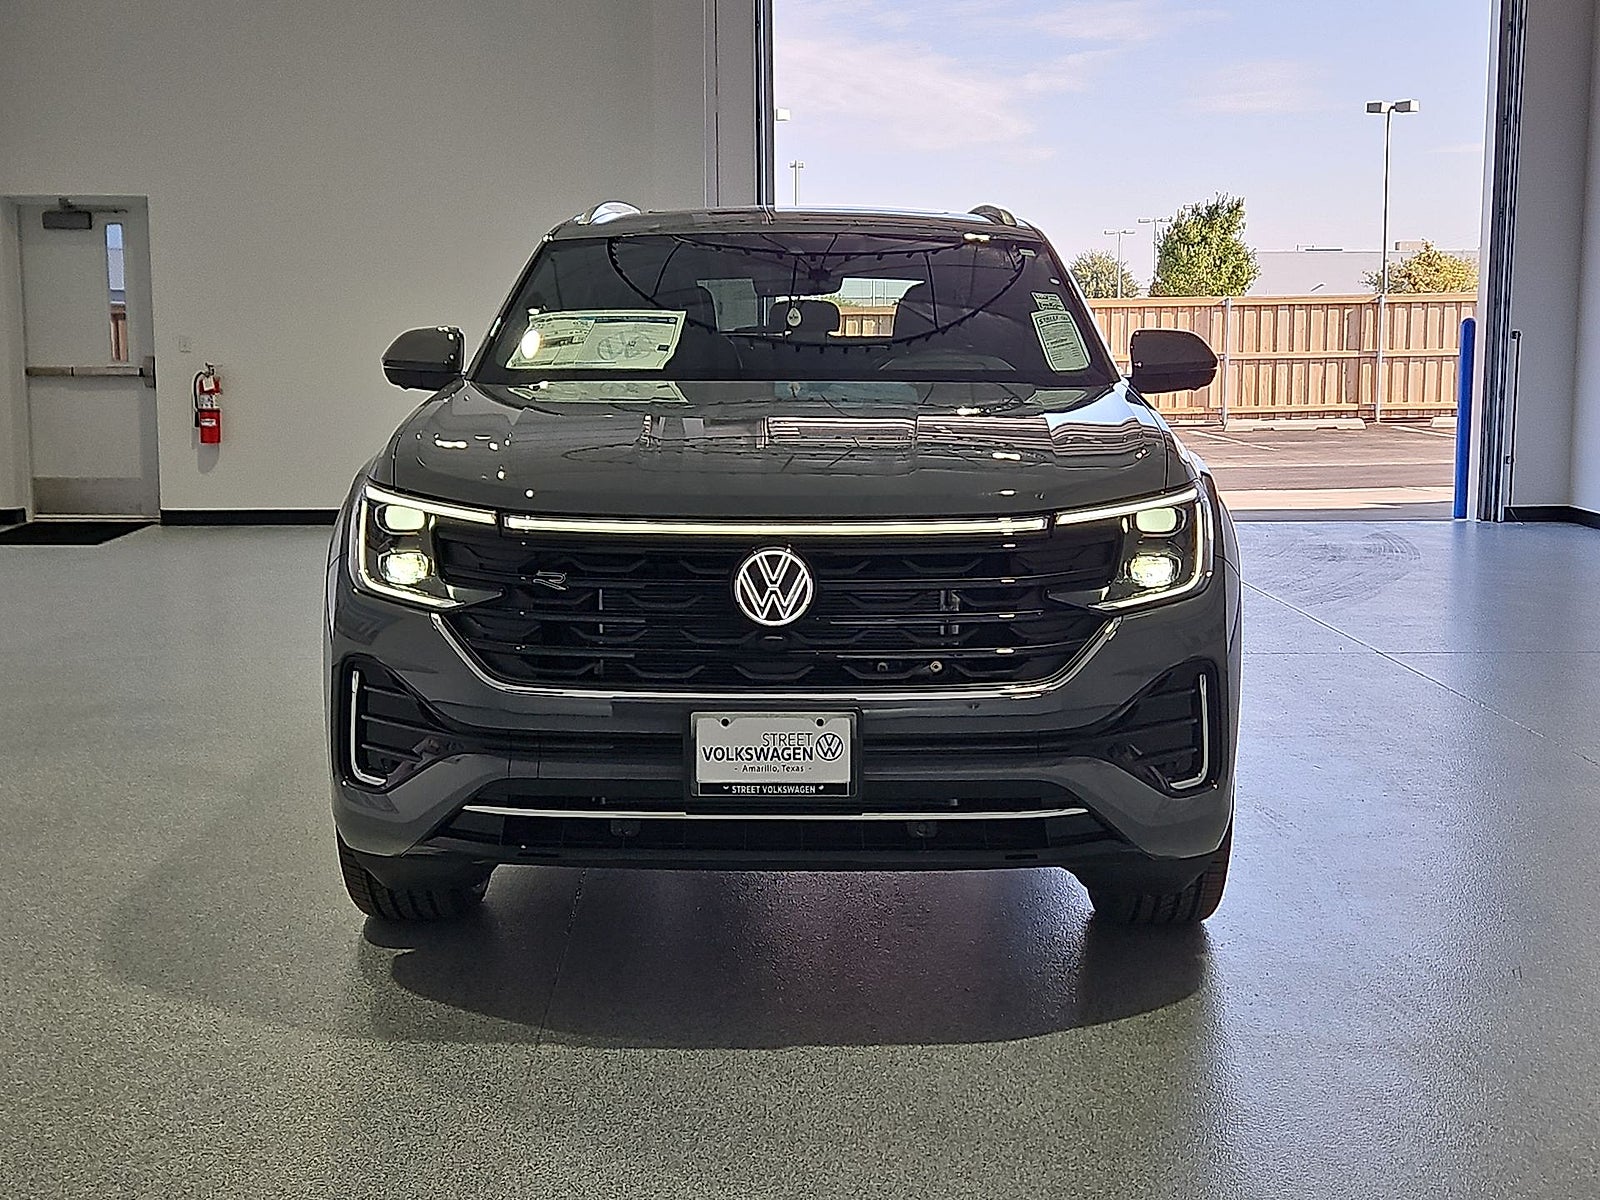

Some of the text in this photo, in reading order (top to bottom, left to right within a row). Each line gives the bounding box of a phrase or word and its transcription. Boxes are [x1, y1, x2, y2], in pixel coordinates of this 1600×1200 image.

[735, 547, 813, 626] VW
[762, 732, 813, 747] STREET
[815, 732, 844, 761] VW
[702, 746, 814, 762] VOLKSWAGEN
[741, 764, 805, 773] Amarillo, Texas
[731, 785, 816, 794] STREET VOLKSWAGEN
